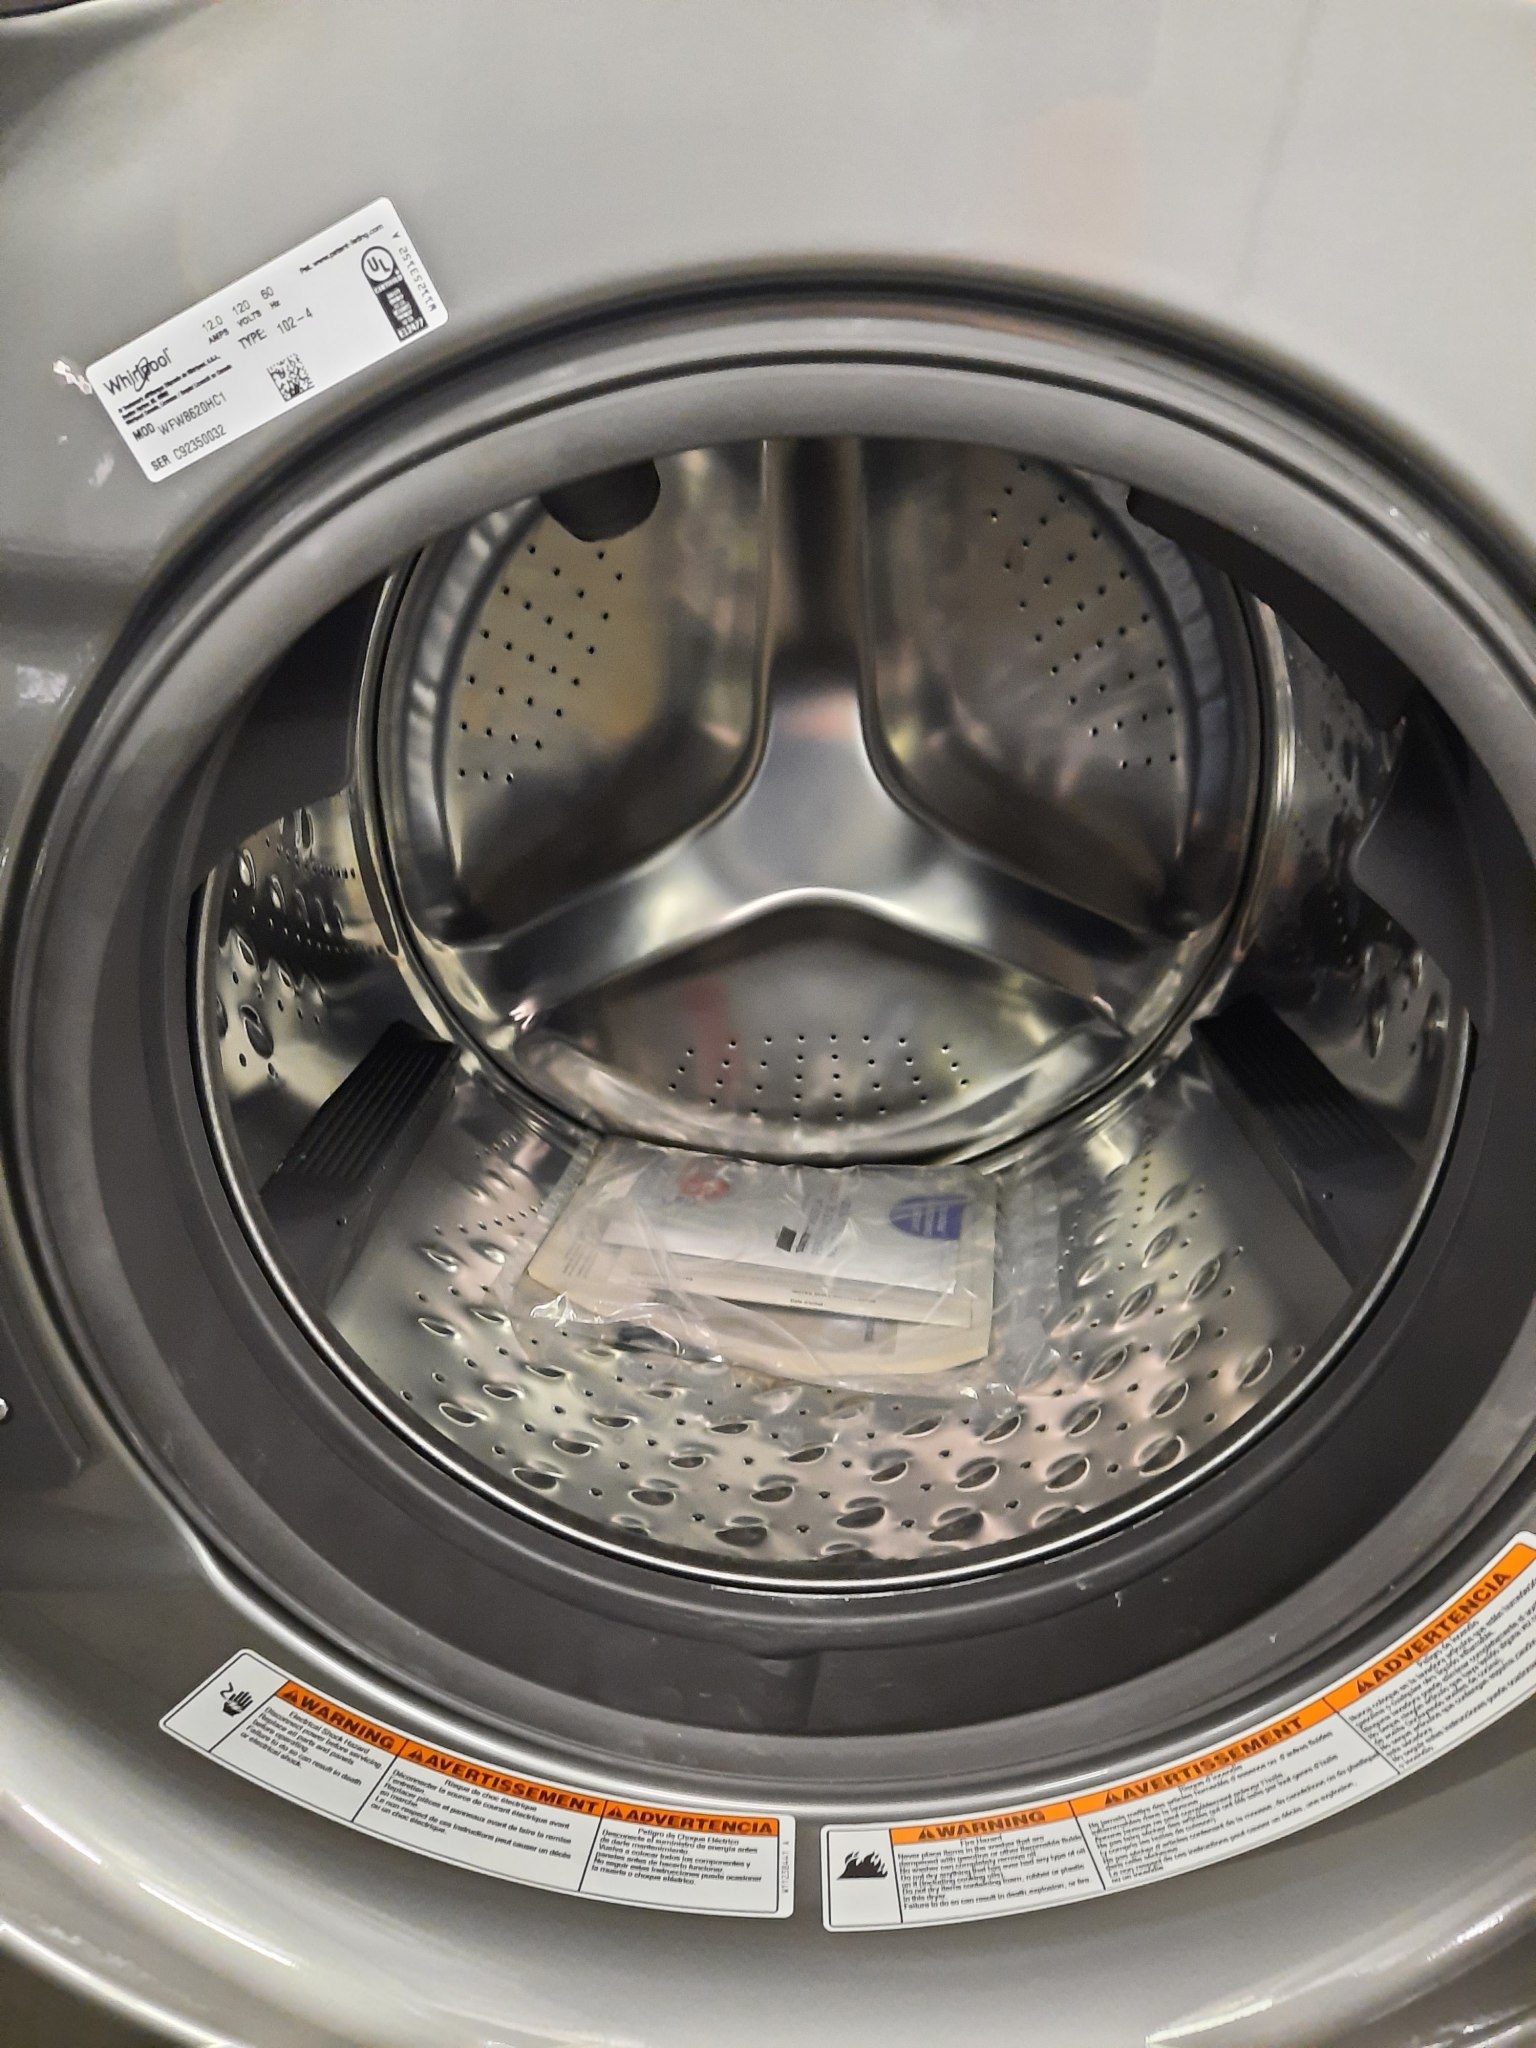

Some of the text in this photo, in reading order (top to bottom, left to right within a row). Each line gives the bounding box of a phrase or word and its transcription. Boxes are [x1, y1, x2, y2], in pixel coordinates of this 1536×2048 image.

[201, 286, 275, 332] 12.0 120 60
[207, 299, 281, 345] AMPS VOLTS Hz
[102, 346, 174, 399] Whirlpool
[132, 391, 226, 441] MOD WFW8620HC1
[150, 423, 227, 472] SER C92350032
[1372, 1572, 1512, 1683] ADVERTENCIA
[239, 1731, 249, 1739] or
[248, 1736, 282, 1757] electrical
[250, 1718, 276, 1735] before
[257, 1712, 355, 1766] Replace all parts and panels
[264, 1706, 304, 1731] Disconnect
[301, 1725, 327, 1742] power
[324, 1735, 350, 1754] before
[288, 1710, 370, 1755] Electrical Shock Hazard
[300, 1695, 395, 1751] WARNING
[245, 1724, 271, 1742] Failure
[270, 1737, 280, 1746] to
[278, 1742, 289, 1751] do
[288, 1747, 299, 1756] so
[297, 1749, 313, 1763] can
[311, 1759, 334, 1773] result
[332, 1768, 342, 1777] in
[1123, 1716, 1302, 1801] AVERTISSEMENT
[423, 1754, 599, 1814] AVERTISSEMENT
[444, 1778, 471, 1793] Risque
[470, 1788, 481, 1797] de
[370, 1803, 381, 1811] ou
[380, 1807, 391, 1815] un
[391, 1810, 410, 1821] choc
[374, 1794, 386, 1804] Le
[428, 1815, 439, 1824] de
[383, 1782, 417, 1799] Replacer
[441, 1804, 451, 1812] et
[486, 1818, 508, 1829] avant
[536, 1830, 545, 1839] la
[438, 1786, 447, 1794] la
[471, 1798, 483, 1806] de
[511, 1809, 548, 1824] électrique
[548, 1820, 570, 1830] avant
[625, 1809, 773, 1834] ADVERTENCIA
[935, 1810, 1046, 1838] WARNING
[599, 1835, 610, 1844] de
[665, 1831, 676, 1839] de
[591, 1864, 599, 1872] la
[593, 1856, 605, 1866] No
[647, 1858, 658, 1866] de
